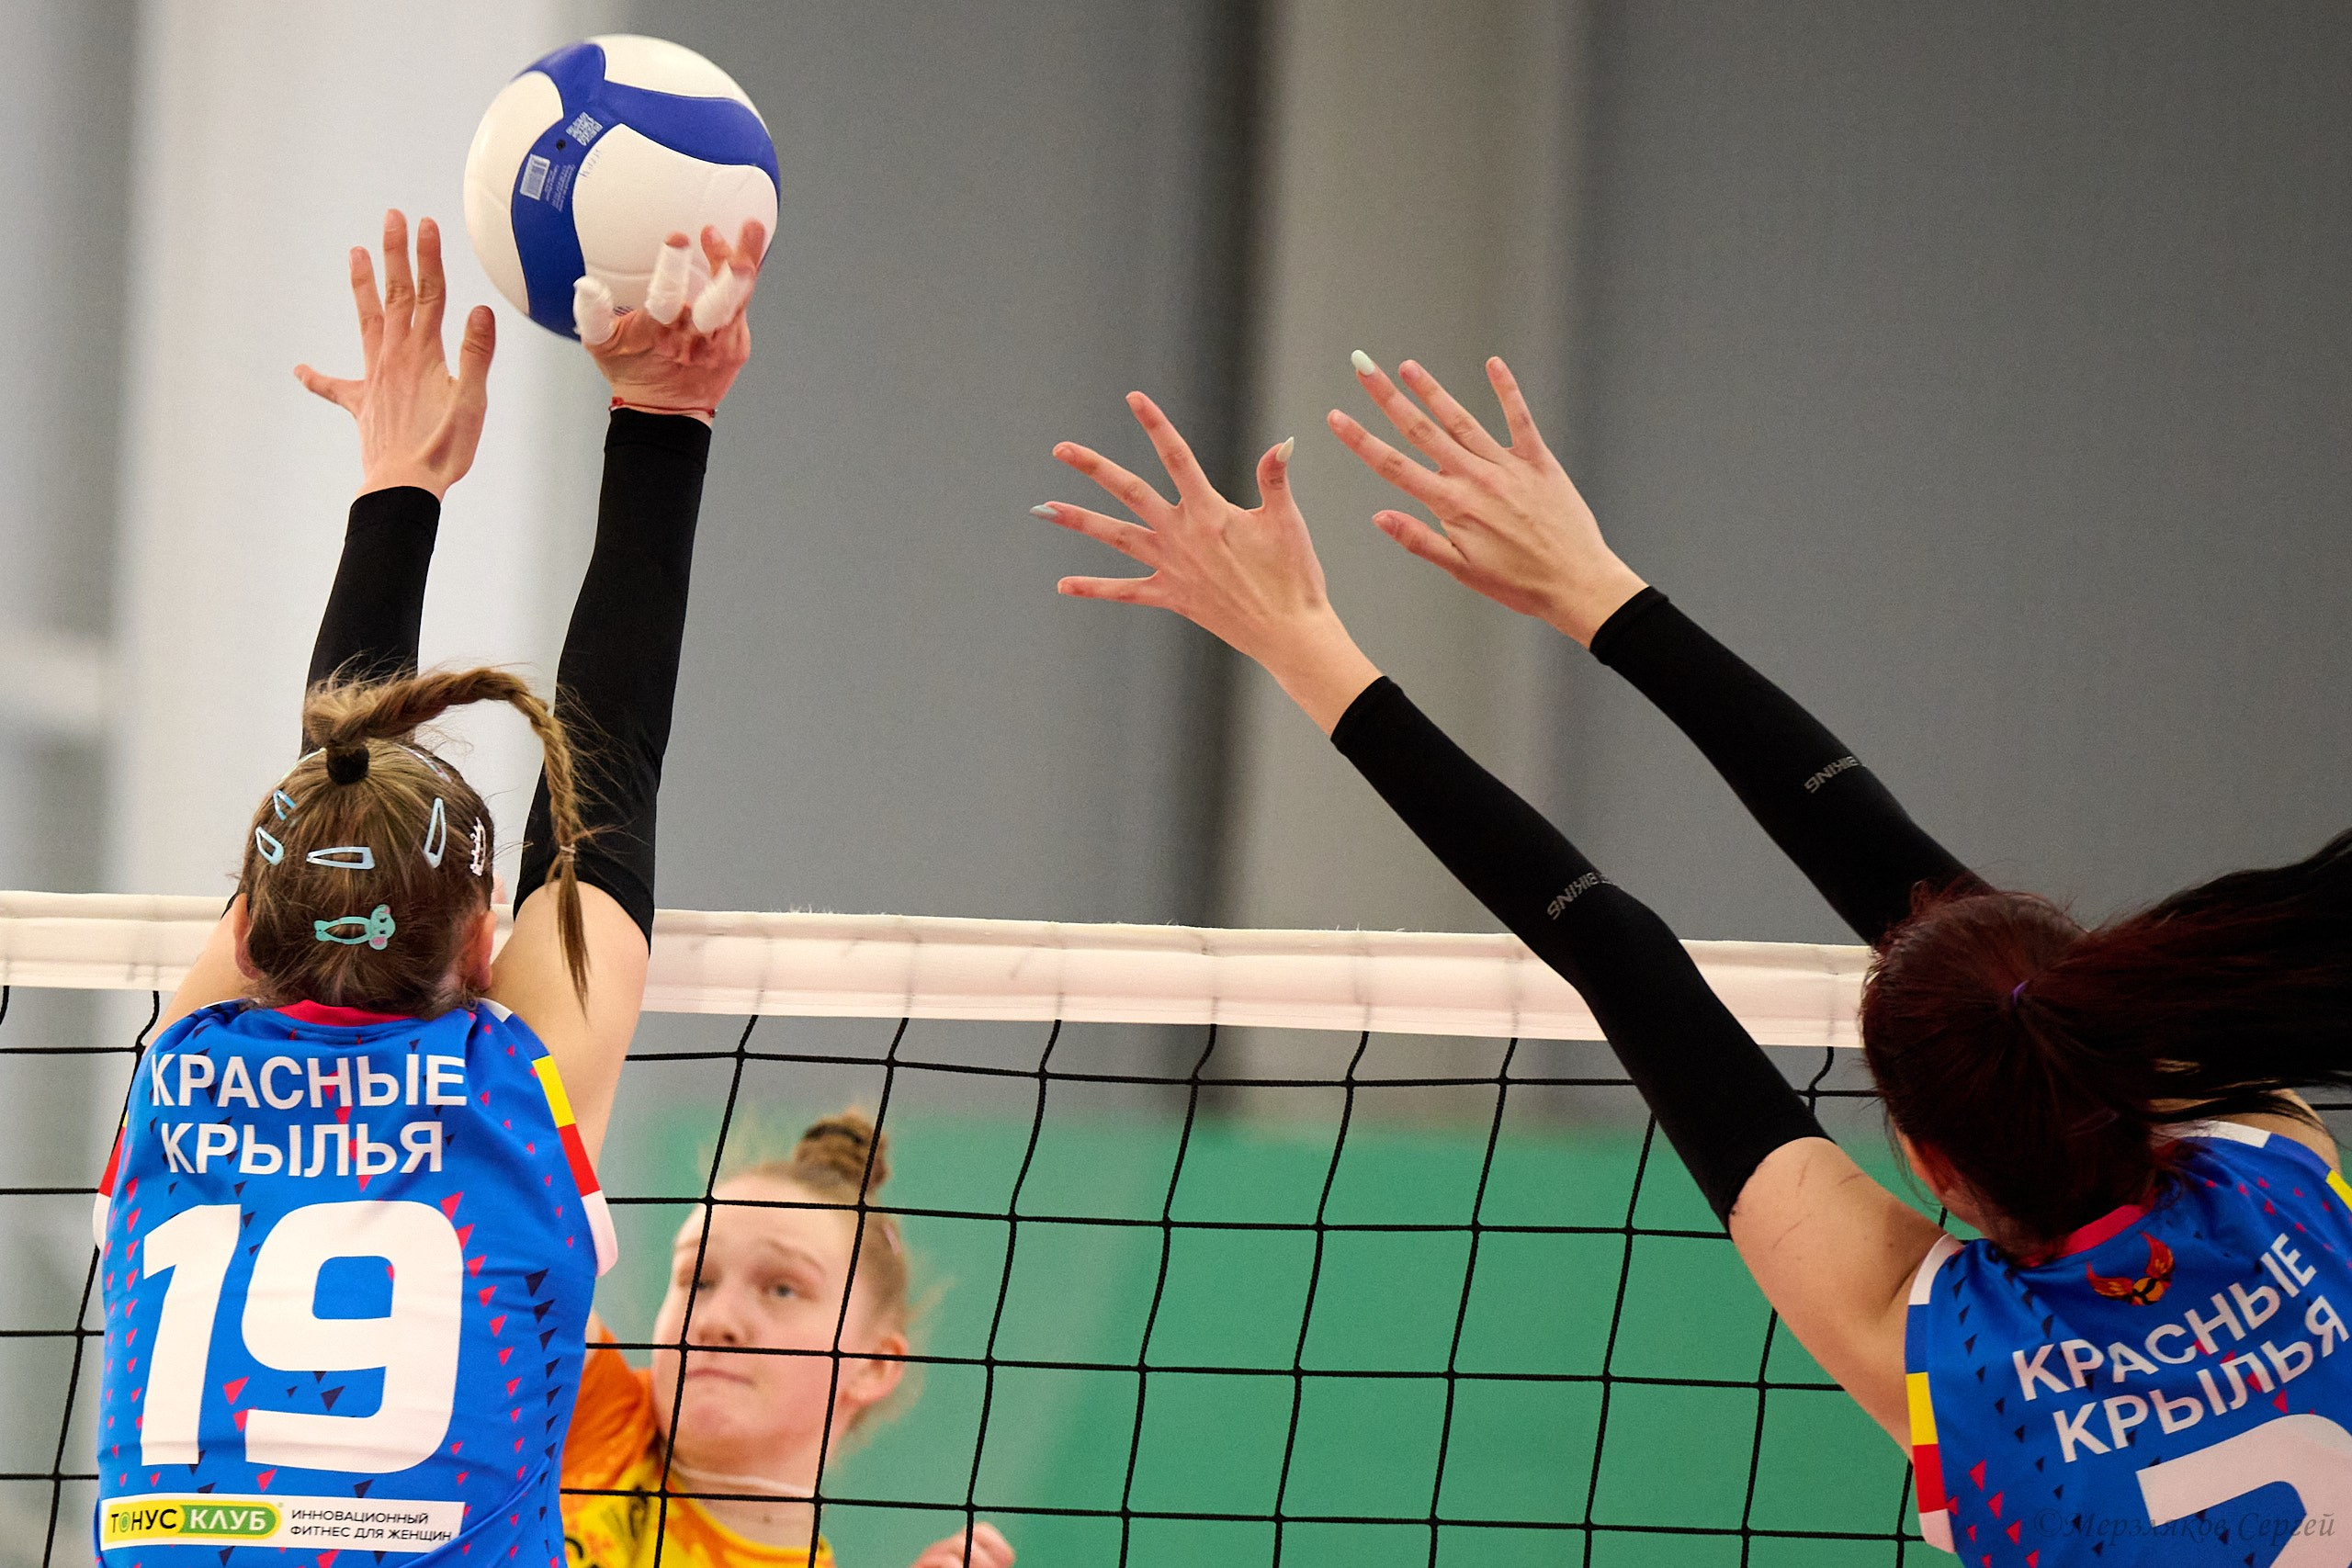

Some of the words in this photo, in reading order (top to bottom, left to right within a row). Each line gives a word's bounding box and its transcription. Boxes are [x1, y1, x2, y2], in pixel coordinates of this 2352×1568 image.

[151, 1053, 468, 1110] КРАСНЫЕ
[160, 1121, 444, 1179] КРЫЛЬЯ
[140, 1200, 464, 1474] 19
[2012, 1233, 2316, 1402] КРАСНЫЕ
[2052, 1295, 2350, 1463] КРЫЛЬЯ
[111, 1508, 178, 1533] ТОНУС
[189, 1509, 266, 1531] КЛУБ
[290, 1526, 351, 1538] ФИТНЕС
[354, 1528, 384, 1540] ДЛЯ
[388, 1529, 452, 1542] ЖЕНЩИН
[291, 1509, 429, 1525] ИННОВАЦИОННЫЙ
